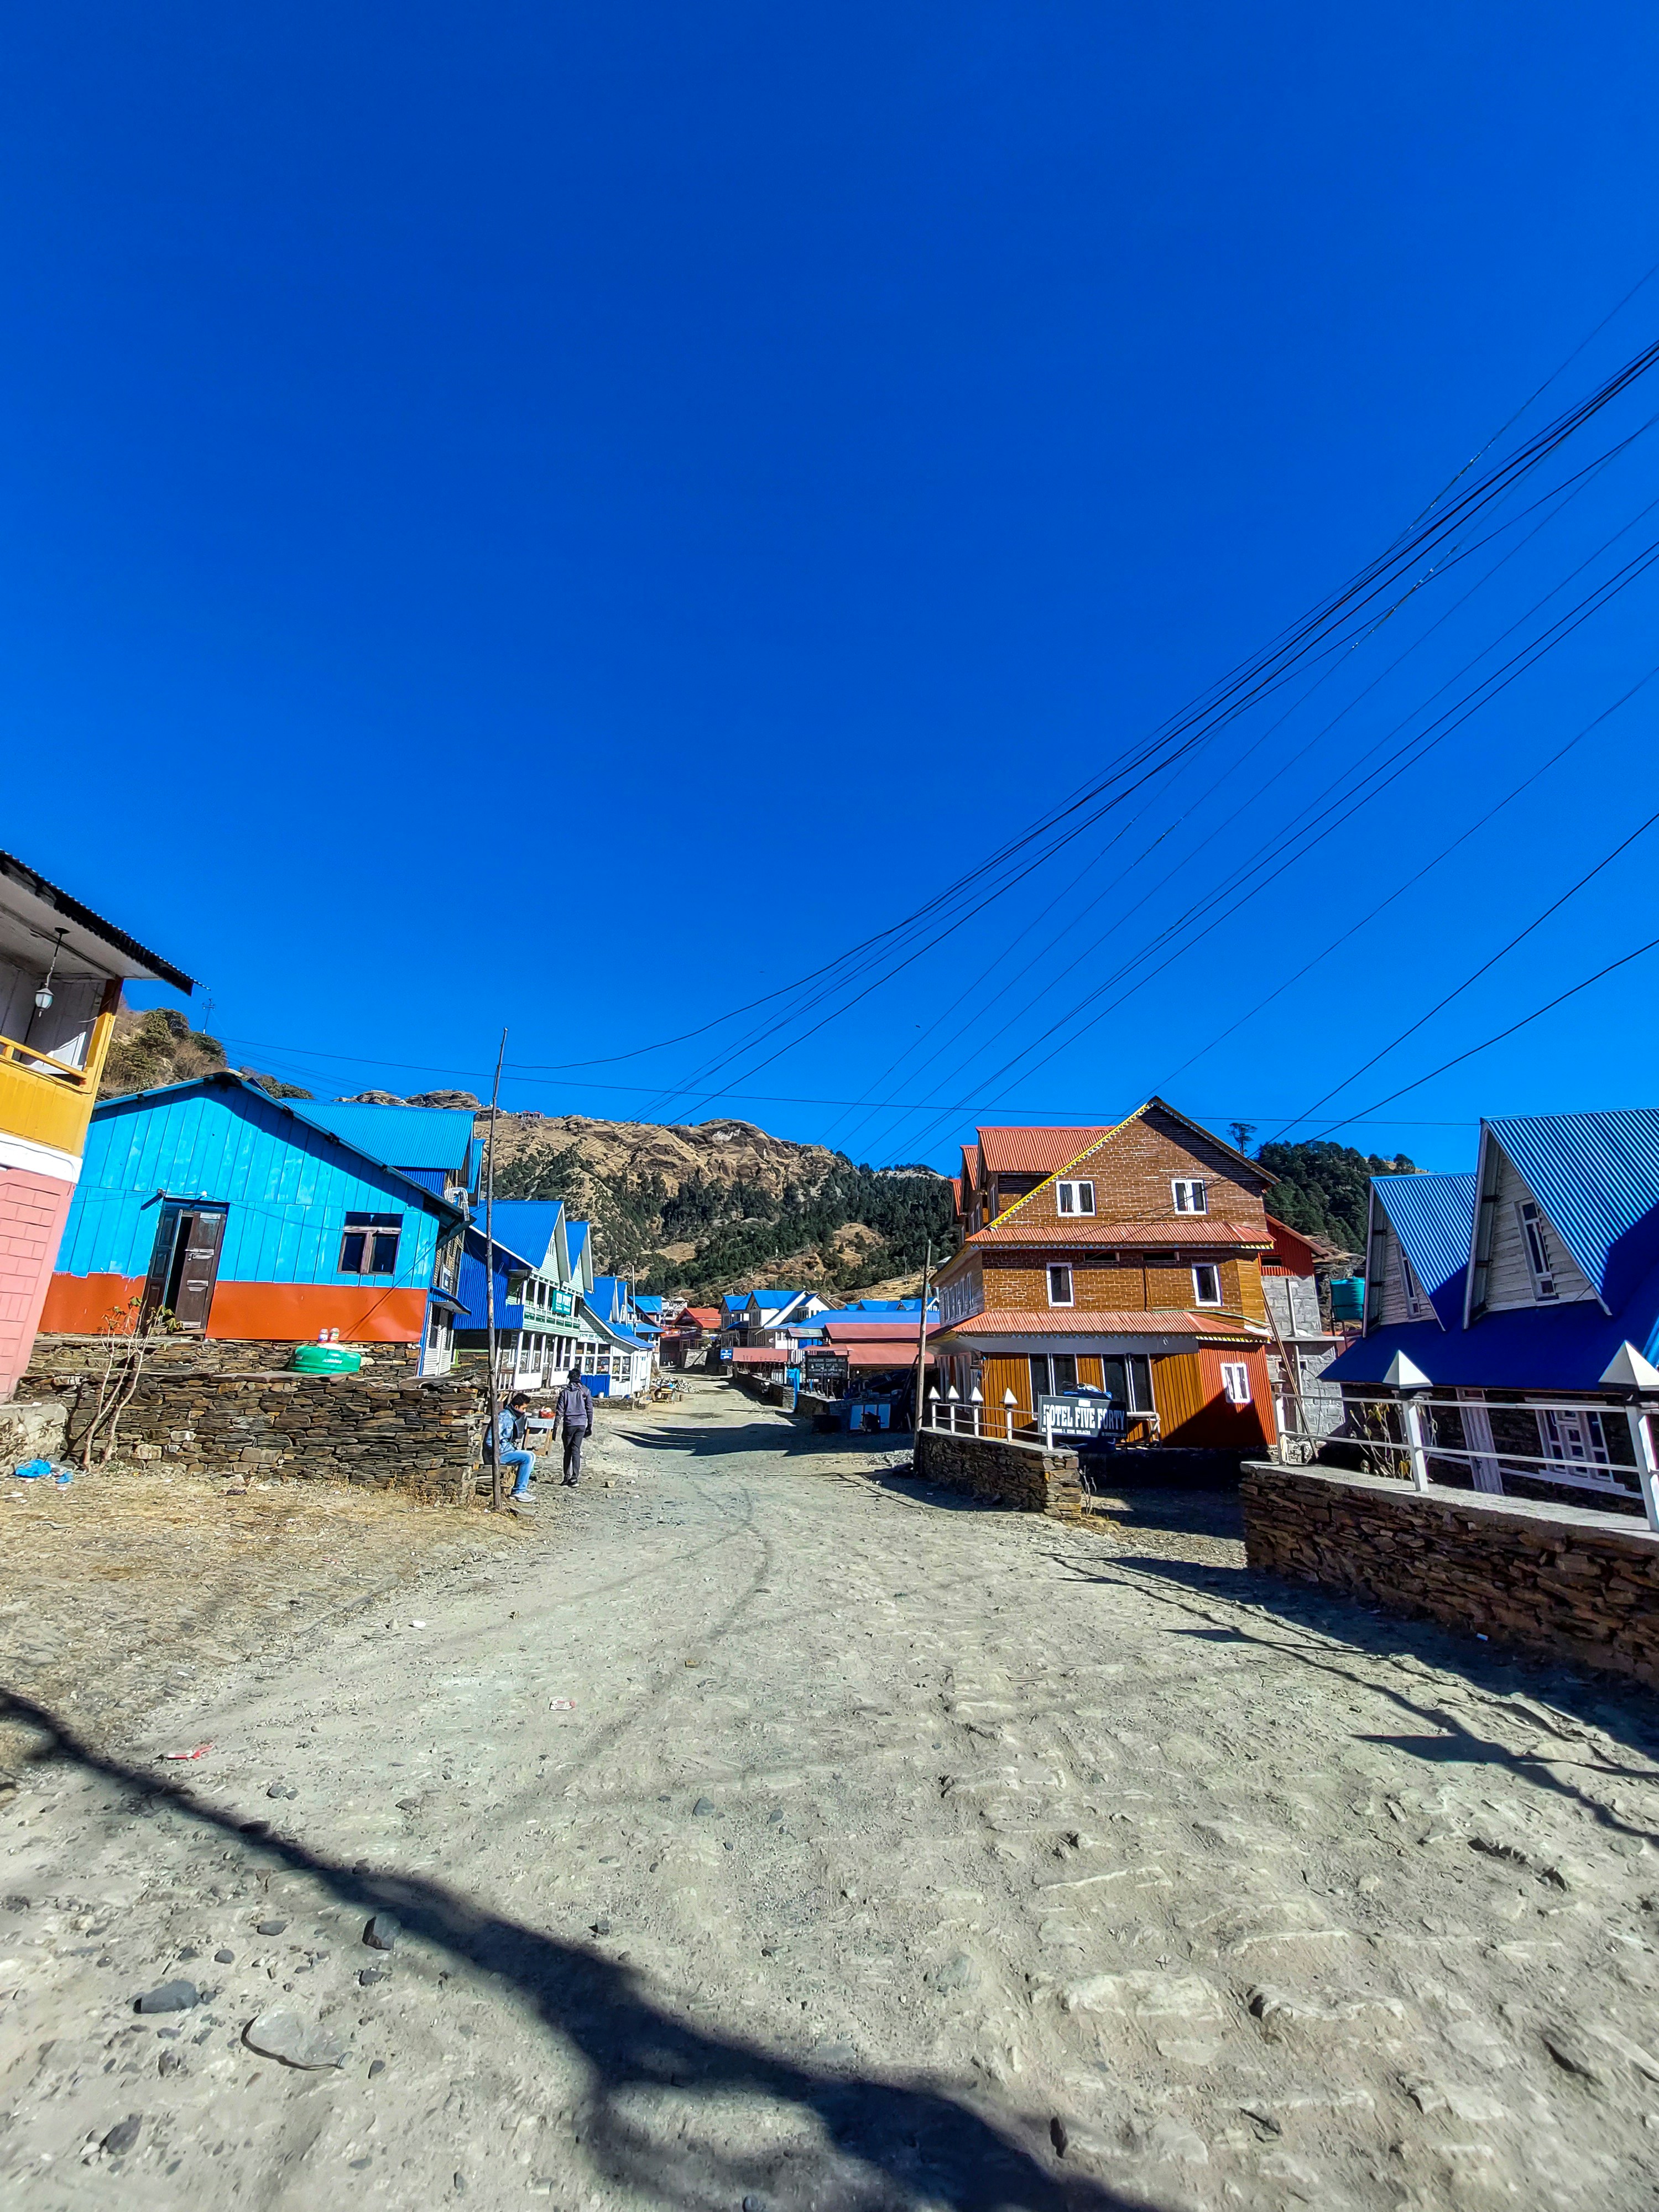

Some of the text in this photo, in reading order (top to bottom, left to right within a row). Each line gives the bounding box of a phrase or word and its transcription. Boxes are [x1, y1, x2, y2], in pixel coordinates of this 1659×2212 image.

[1043, 1405, 1125, 1430] HOTEL FIVE FORTY
